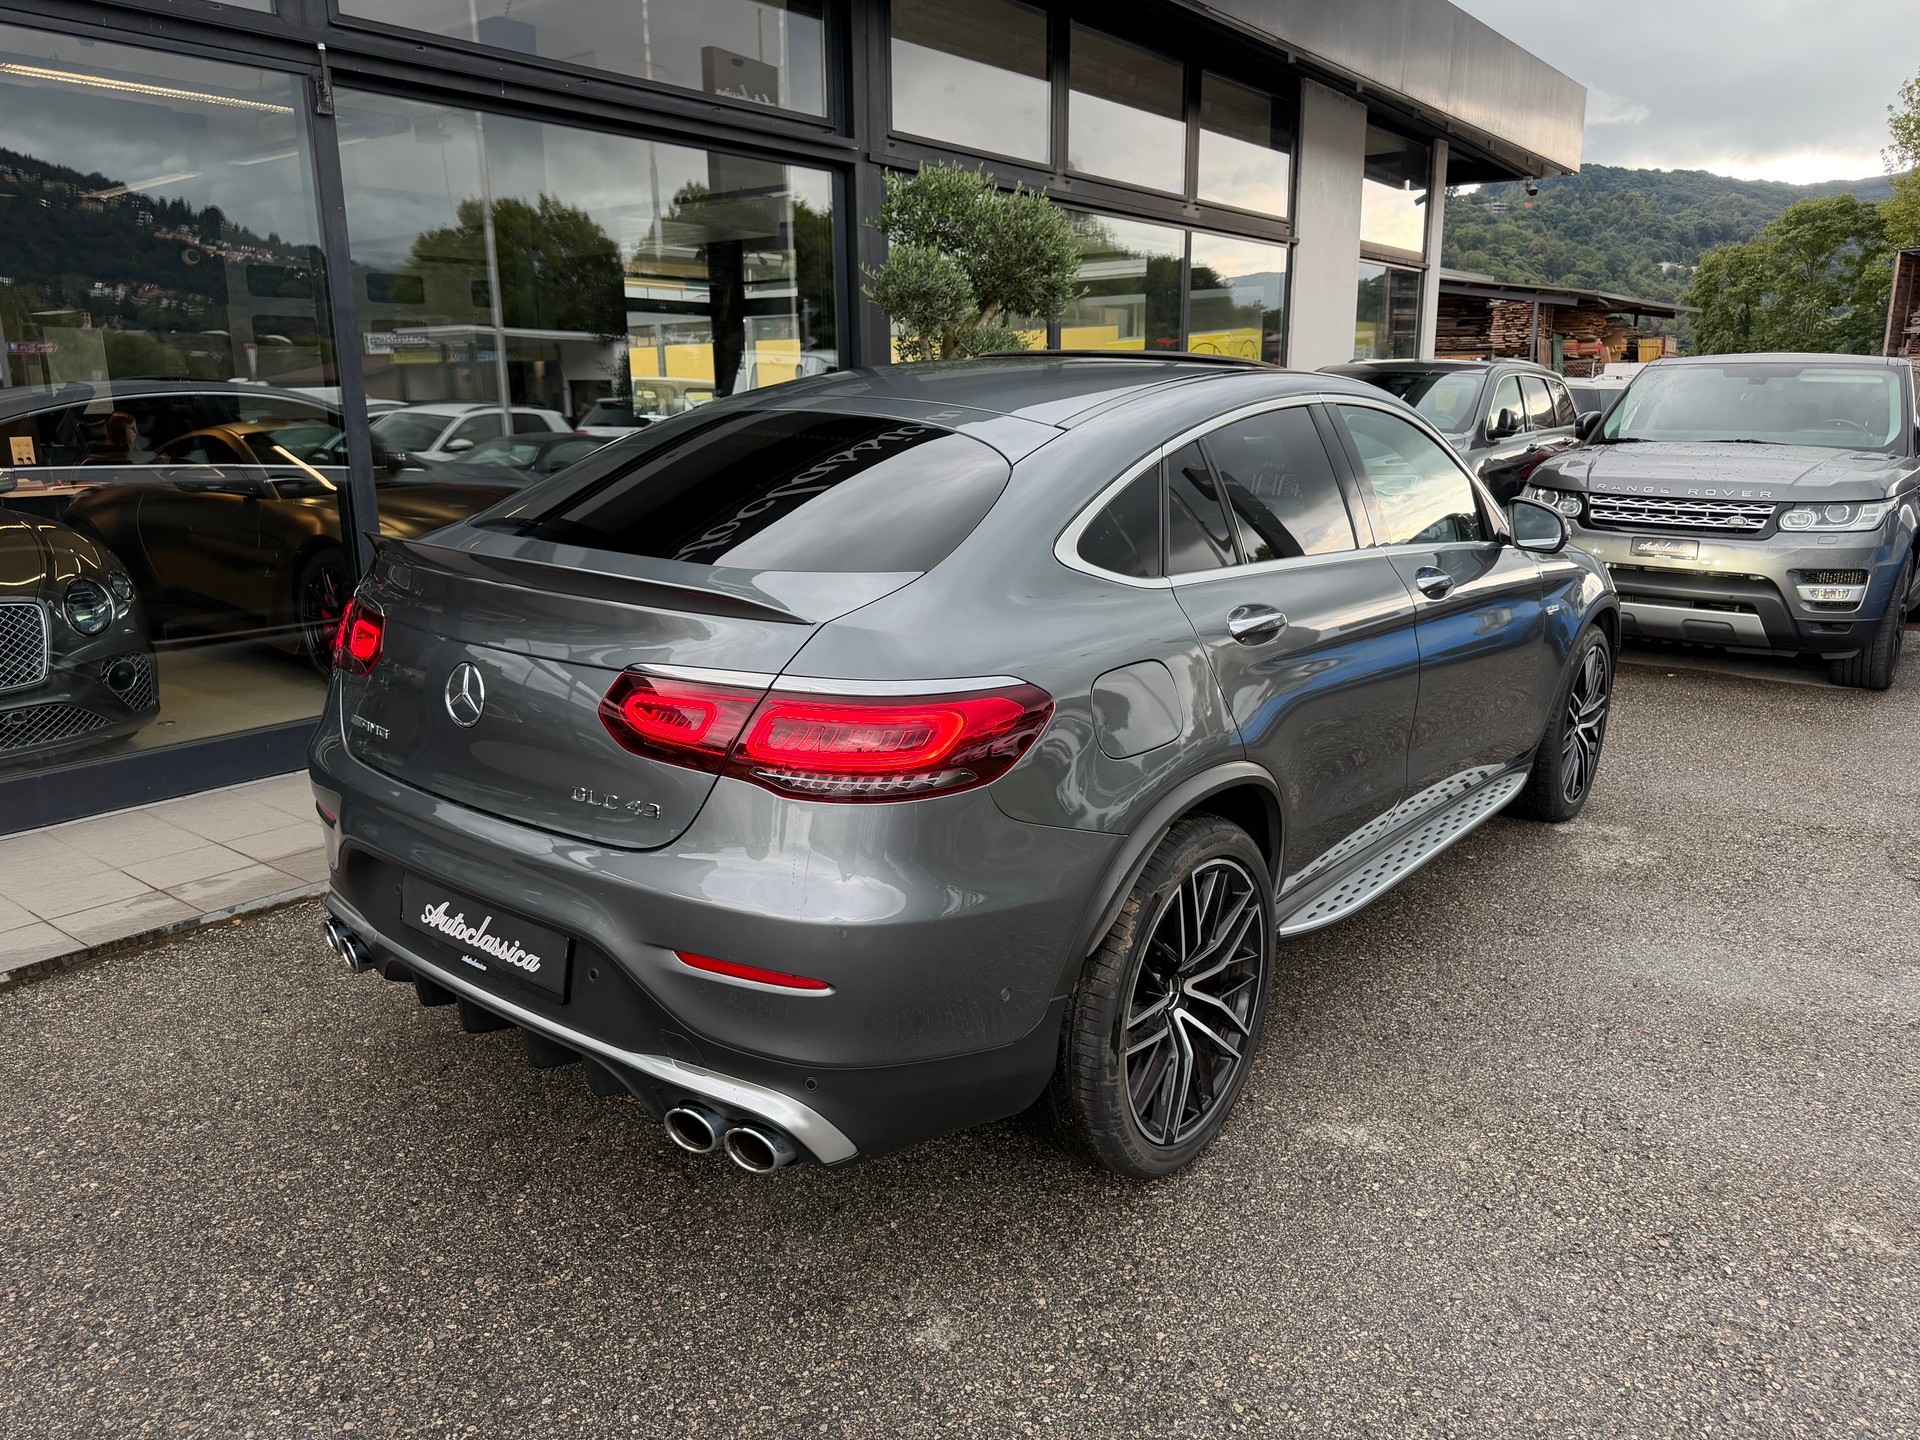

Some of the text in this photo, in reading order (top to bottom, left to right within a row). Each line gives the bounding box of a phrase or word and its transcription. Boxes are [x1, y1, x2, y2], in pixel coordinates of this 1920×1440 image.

[1596, 483, 1772, 498] RANGE ROVER
[571, 785, 661, 819] GLC 43
[420, 901, 541, 973] Autoclassica
